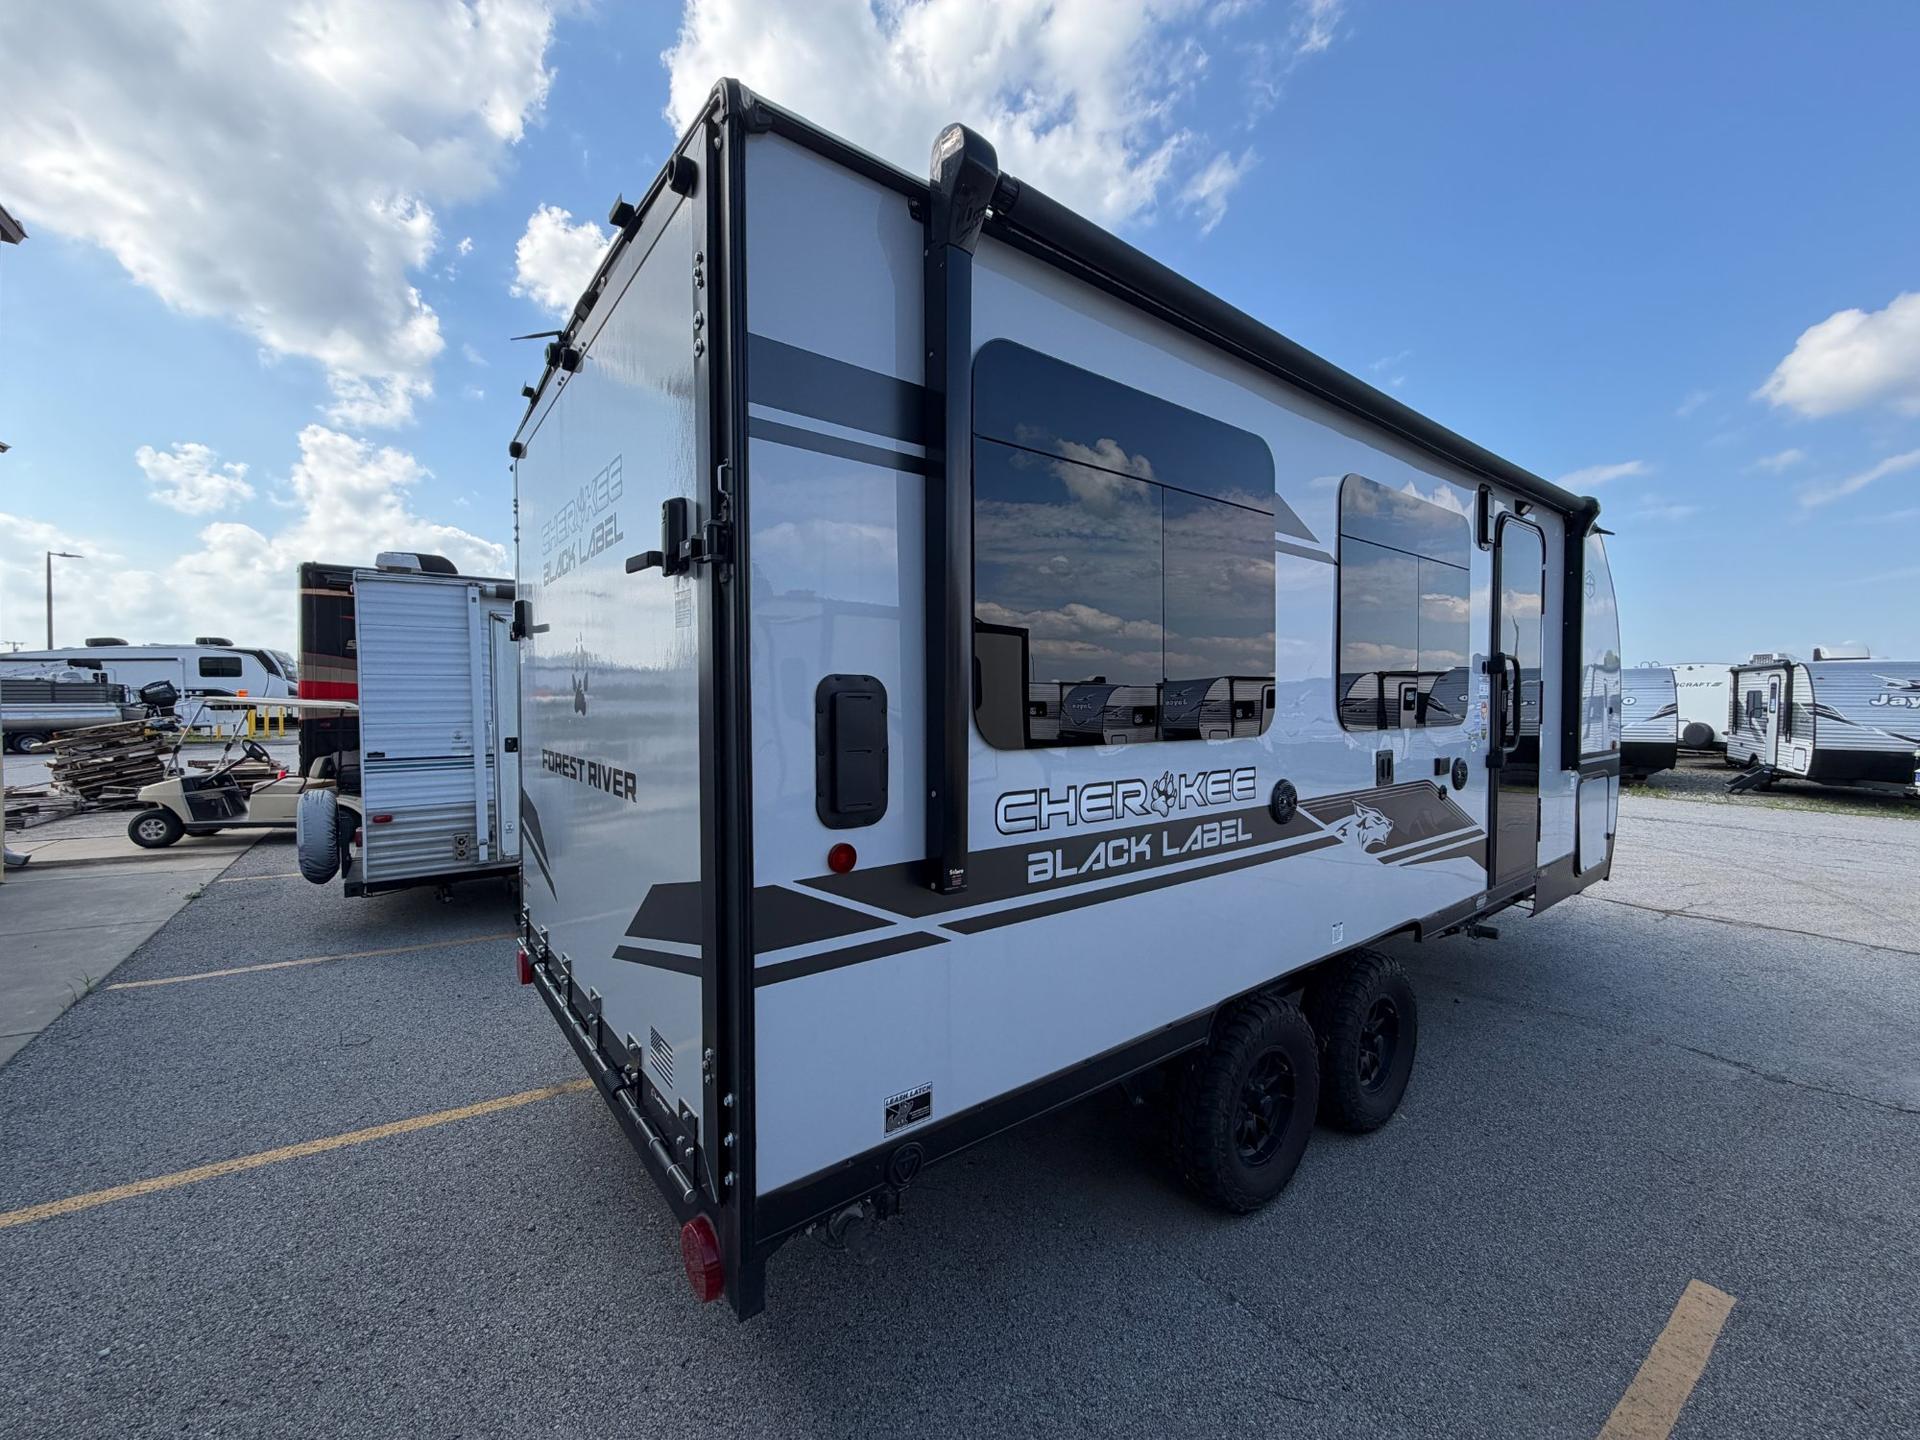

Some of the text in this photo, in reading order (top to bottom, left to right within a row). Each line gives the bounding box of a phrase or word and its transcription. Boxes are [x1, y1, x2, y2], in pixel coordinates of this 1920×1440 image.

[543, 511, 624, 587] BLACK LABEL
[542, 749, 637, 803] FOREST RIVER
[1027, 818, 1253, 884] BLACK LABEL
